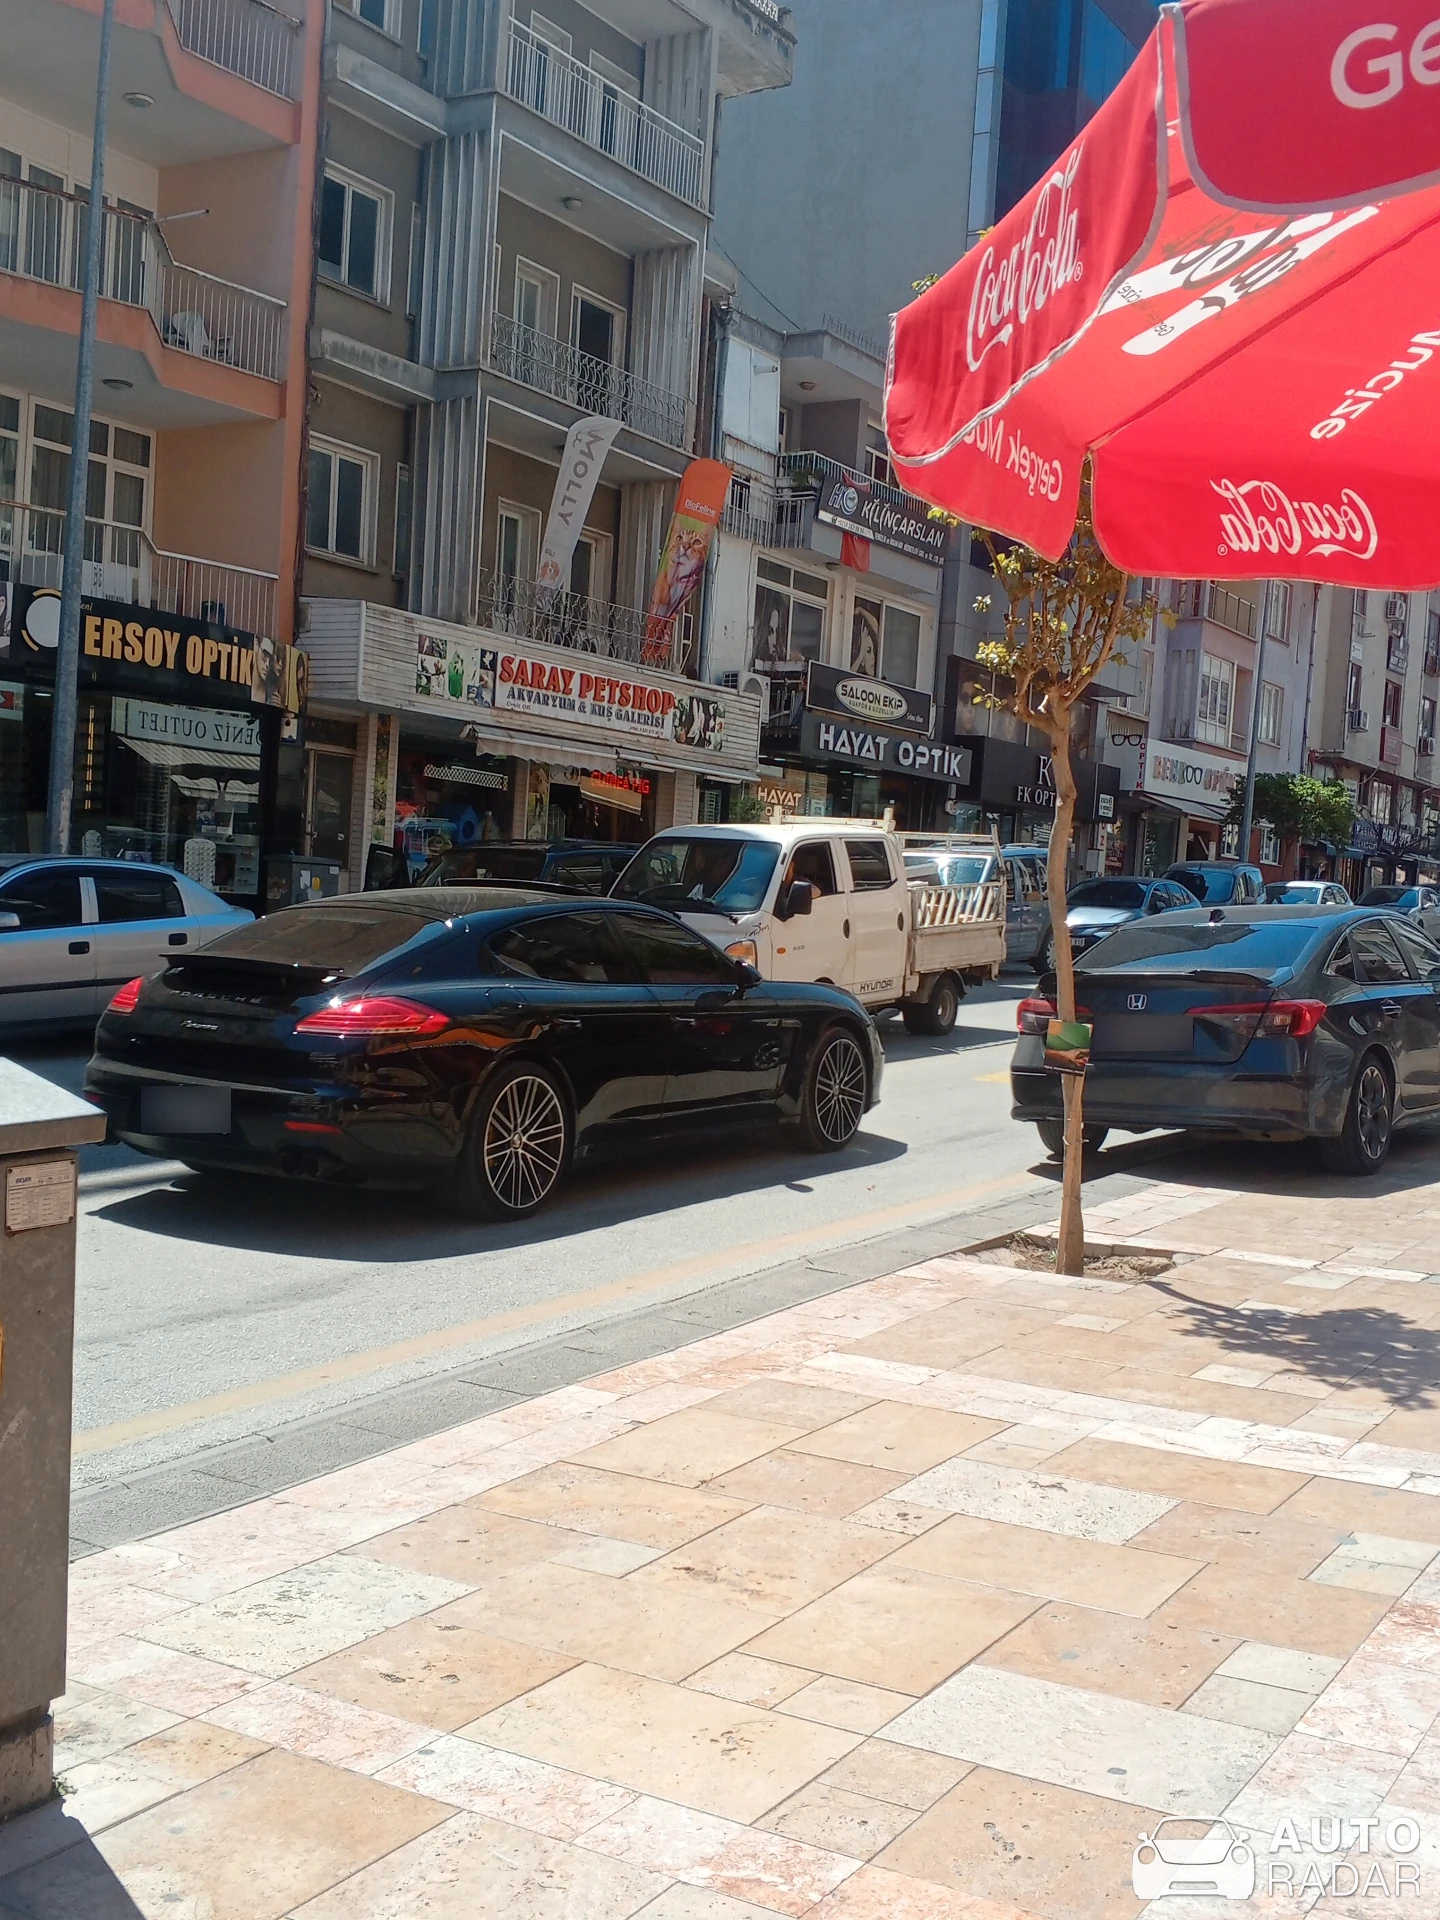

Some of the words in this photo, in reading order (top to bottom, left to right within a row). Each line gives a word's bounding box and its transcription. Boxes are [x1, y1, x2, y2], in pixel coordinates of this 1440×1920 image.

[966, 138, 1086, 373] Coca-Cola
[557, 429, 605, 527] MOLLY
[84, 615, 181, 670] ERSOY
[185, 633, 253, 686] OPTİK
[499, 655, 575, 696] SARAY
[578, 672, 676, 716] PETSHOP
[841, 684, 880, 706] SALOON
[882, 695, 903, 711] EKİP
[506, 687, 576, 712] AKVARYUM
[577, 702, 587, 714] &
[590, 702, 613, 722] KUŞ
[614, 709, 665, 729] GALERİSİ
[819, 722, 890, 762] HAYAT
[898, 741, 964, 778] OPTİK
[757, 786, 803, 807] HAYAT
[1016, 785, 1032, 803] FK
[1034, 788, 1056, 808] OPT
[169, 989, 262, 1004] PORSCHE
[859, 979, 894, 993] HYUNDAI
